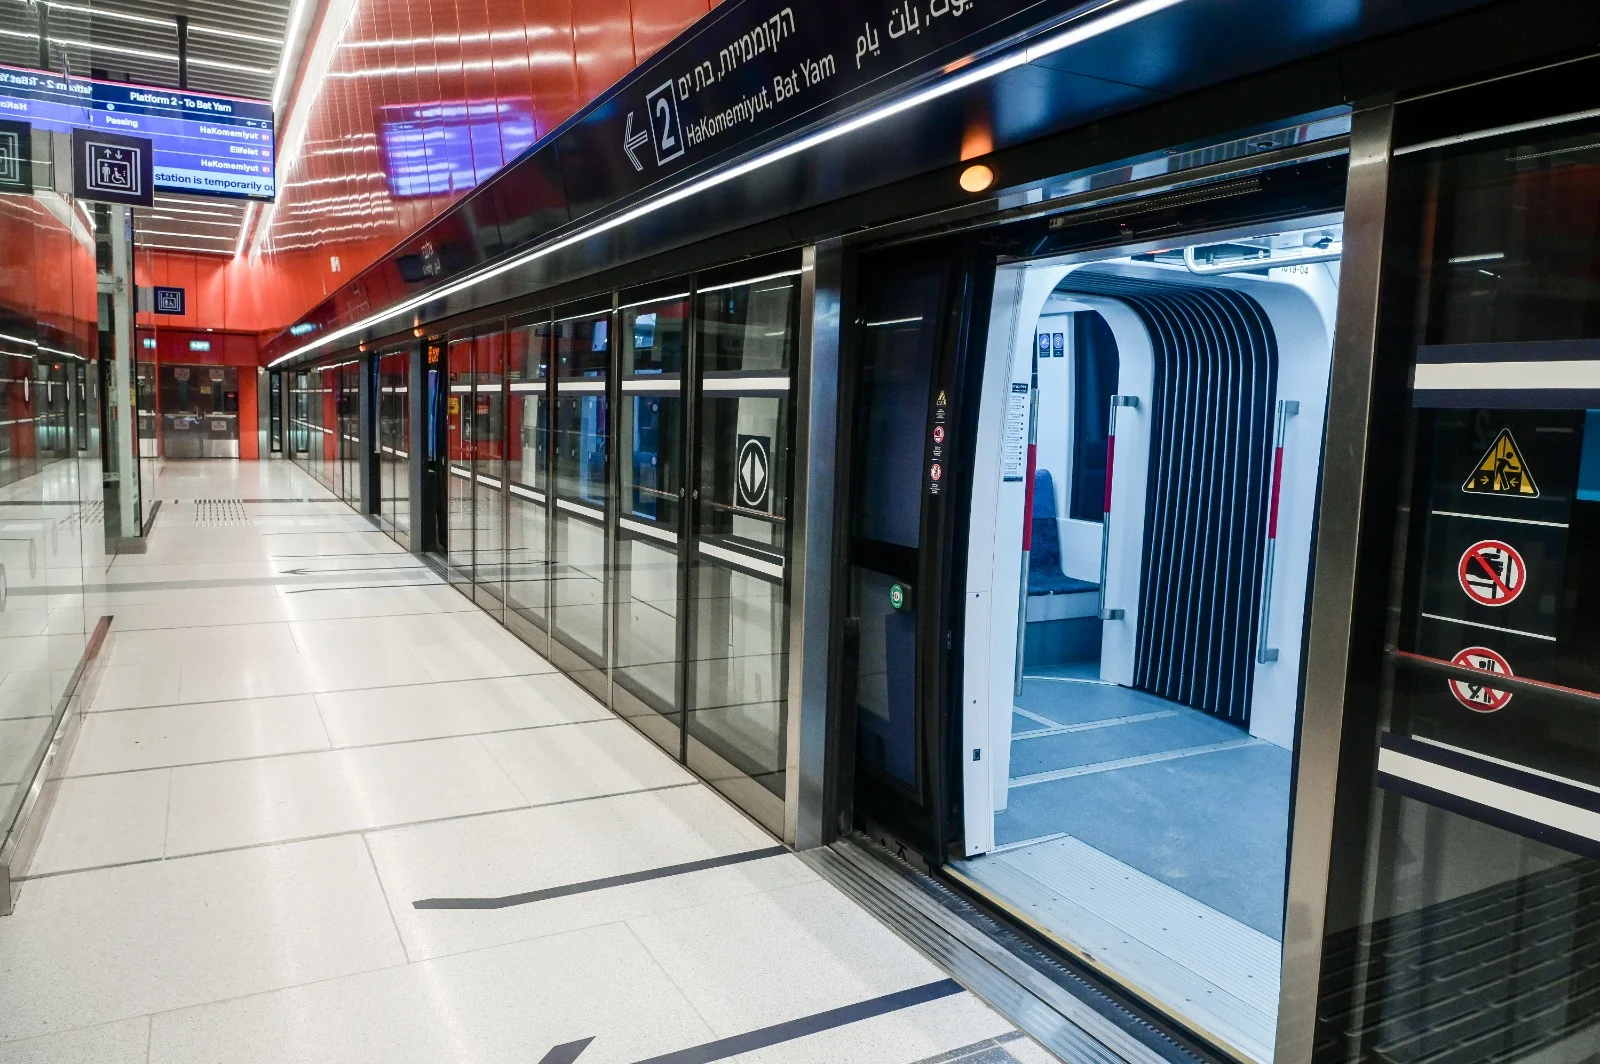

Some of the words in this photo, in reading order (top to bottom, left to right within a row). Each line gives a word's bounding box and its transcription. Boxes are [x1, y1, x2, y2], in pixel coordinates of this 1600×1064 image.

[888, 0, 920, 39] بات
[717, 7, 796, 82] הקוממיות,
[855, 22, 881, 69] يام
[677, 73, 692, 101] ים
[694, 60, 715, 92] בת
[129, 91, 170, 106] Platform
[170, 96, 178, 106] 2
[184, 98, 196, 108] To
[196, 100, 213, 110] Bat
[213, 102, 232, 113] Yam
[685, 86, 773, 147] HaKomemiyut,
[773, 69, 800, 103] Bat
[799, 53, 836, 87] Yam
[105, 115, 139, 128] Passing
[199, 125, 259, 140] HaKomemiyut
[656, 97, 676, 150] 2
[200, 159, 260, 173] HaKomemiyut
[155, 172, 191, 184] station
[193, 173, 202, 184] is
[204, 174, 262, 192] temporarily
